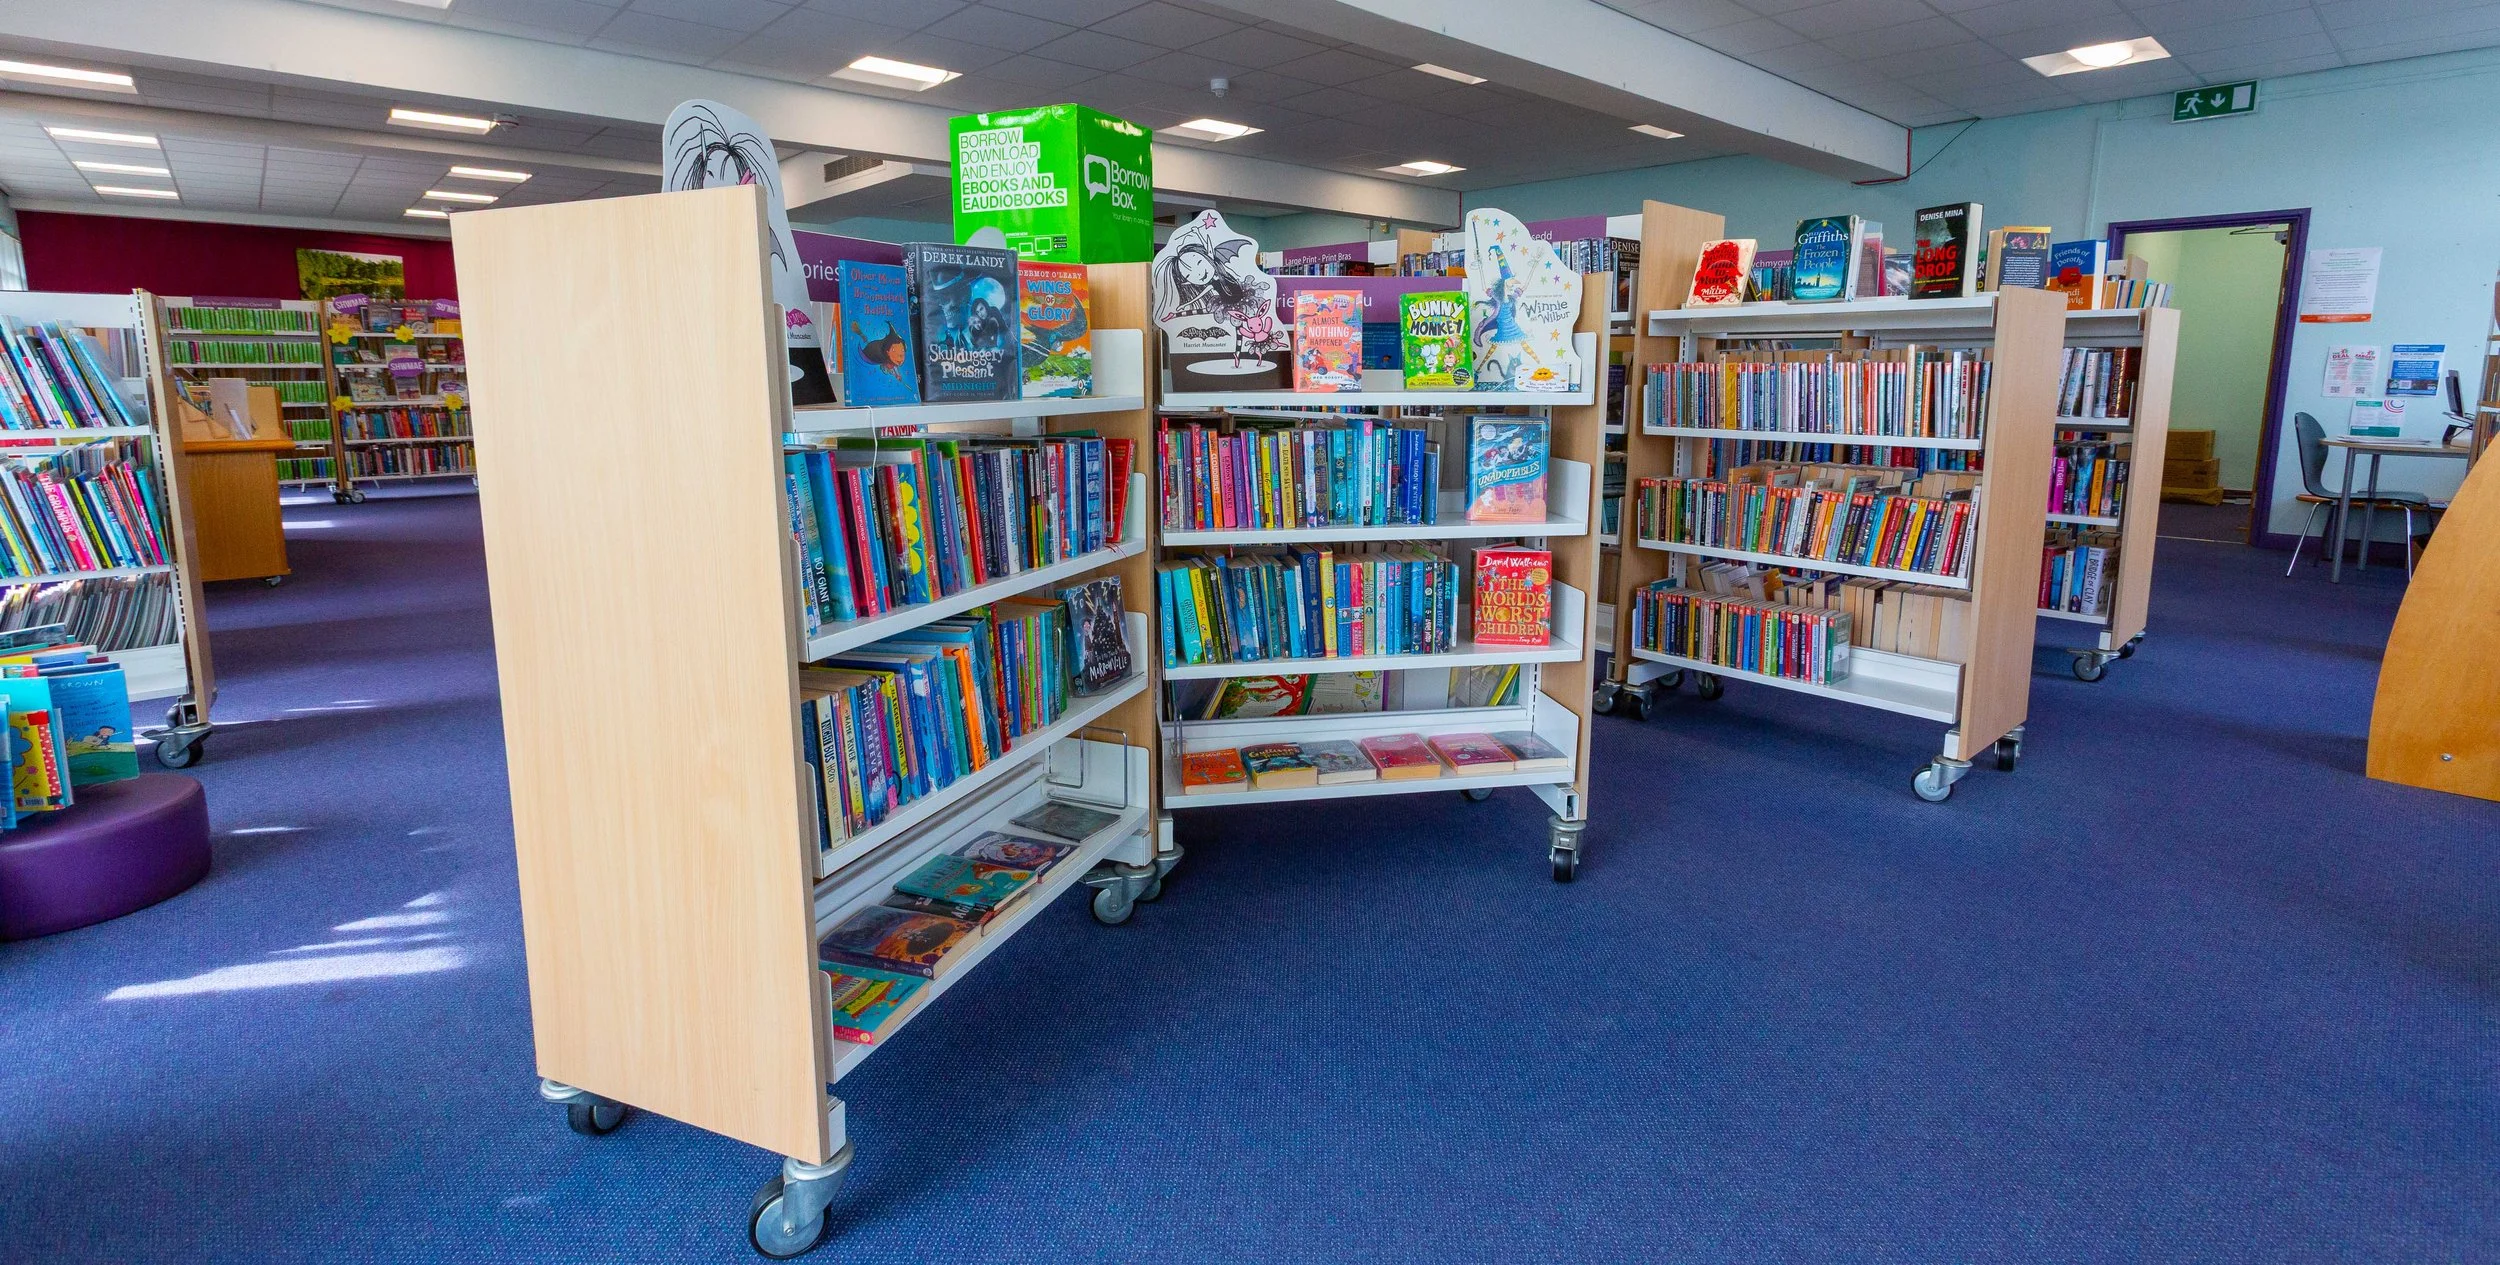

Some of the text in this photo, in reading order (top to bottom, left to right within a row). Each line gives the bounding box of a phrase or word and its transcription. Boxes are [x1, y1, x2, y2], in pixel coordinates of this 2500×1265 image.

[960, 130, 1021, 149] BORROW
[961, 145, 1039, 164] DOWNLOAD
[962, 162, 1035, 180] AND ENJOY
[1112, 160, 1150, 191] Borrow
[963, 176, 1052, 195] EBOOKS AND
[963, 191, 1065, 211] EAUDIOBOOKS
[1920, 209, 1964, 222] DENISE MINA
[1611, 240, 1640, 252] DENISE
[1798, 230, 1849, 245] Griffiths
[923, 252, 1006, 269] DEREK LANDY
[1286, 258, 1301, 266] Large
[1303, 256, 1317, 264] Print
[1322, 254, 1337, 262] Print
[1803, 249, 1839, 258] Frozen
[1916, 245, 1957, 264] LONG
[2055, 248, 2081, 259] Friends
[2057, 257, 2085, 267] Dorothy
[1803, 259, 1837, 271] People
[1915, 261, 1956, 278] DROP
[1019, 269, 1082, 279] DERMOT O'LEARY
[1027, 280, 1072, 295] WINGS
[336, 298, 369, 310] SHWMAE
[1409, 300, 1465, 320] BUNNY
[1519, 300, 1568, 318] Winnie
[1028, 307, 1072, 321] GLORY
[1312, 317, 1339, 326] ALMOST
[1538, 311, 1571, 324] Wilbur
[1309, 326, 1350, 338] NOTHING
[1410, 319, 1464, 336] MONKEY
[1310, 339, 1343, 347] HAPPENED
[930, 344, 1005, 366] Skulduggery
[390, 362, 424, 371] SHWMAE
[942, 362, 994, 379] Pleasant
[942, 382, 996, 391] MIDNIGHT
[1477, 461, 1540, 488] UNADOPTABLES
[852, 475, 860, 504] MICHAEL
[41, 476, 74, 533] THE GRUMPUS
[938, 497, 946, 516] SILENT
[854, 505, 866, 541] MORPURGO
[943, 536, 948, 545] GO
[944, 545, 949, 554] BY
[1479, 556, 1549, 568] David Walliams
[814, 558, 830, 603] BOY GIANT
[1499, 578, 1526, 591] THE
[2084, 559, 2099, 605] BRIDGE CLAY
[1481, 591, 1547, 607] WORLD'S
[1481, 606, 1545, 625] WORST
[1478, 623, 1544, 636] CHILDREN
[892, 698, 901, 728] LEGEND
[861, 689, 877, 775] PHILIP REEVE
[821, 720, 836, 764] NIGHT BUS
[896, 734, 905, 758] KEVIN
[847, 740, 856, 763] RIVER
